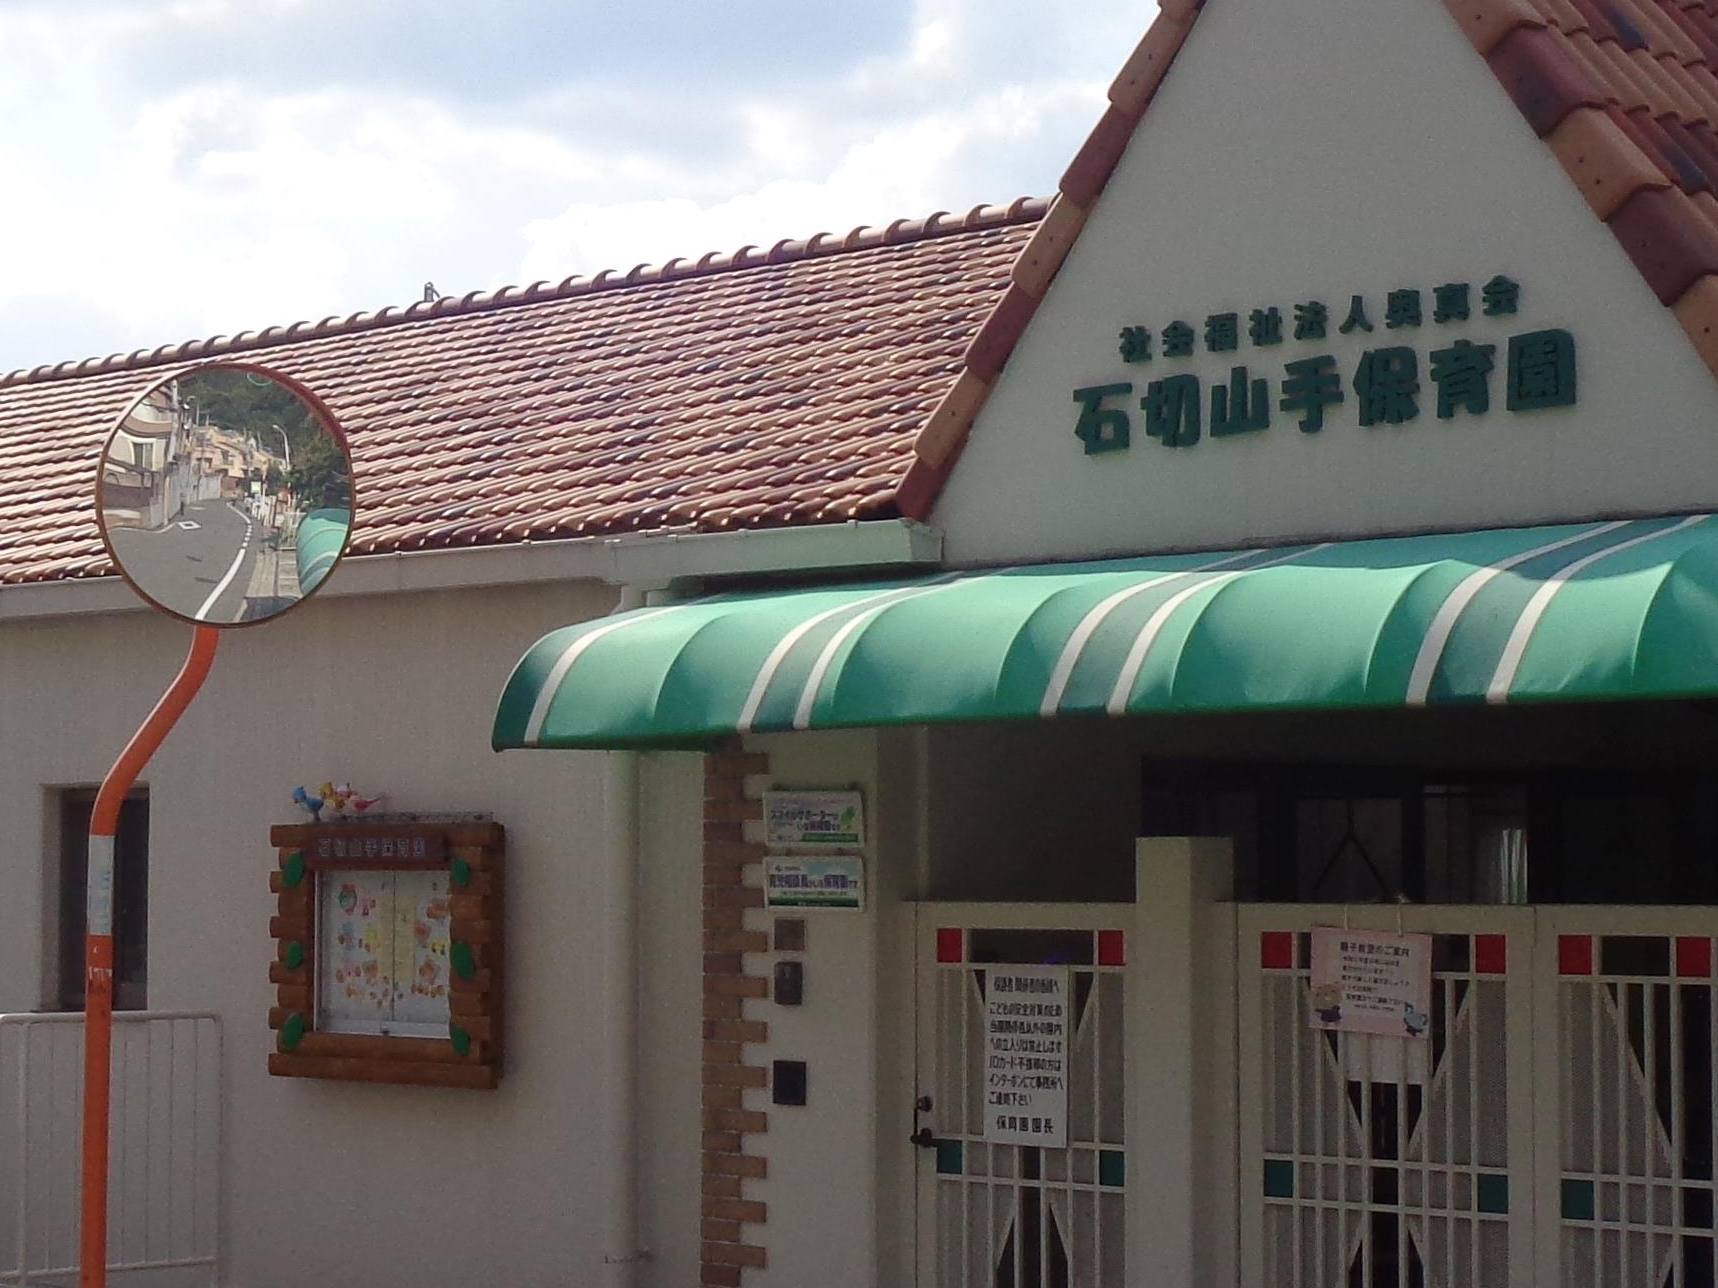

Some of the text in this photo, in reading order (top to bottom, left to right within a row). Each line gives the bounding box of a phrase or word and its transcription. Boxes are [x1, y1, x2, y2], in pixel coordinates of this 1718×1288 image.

[1072, 327, 1577, 455] 石切山手保育園
